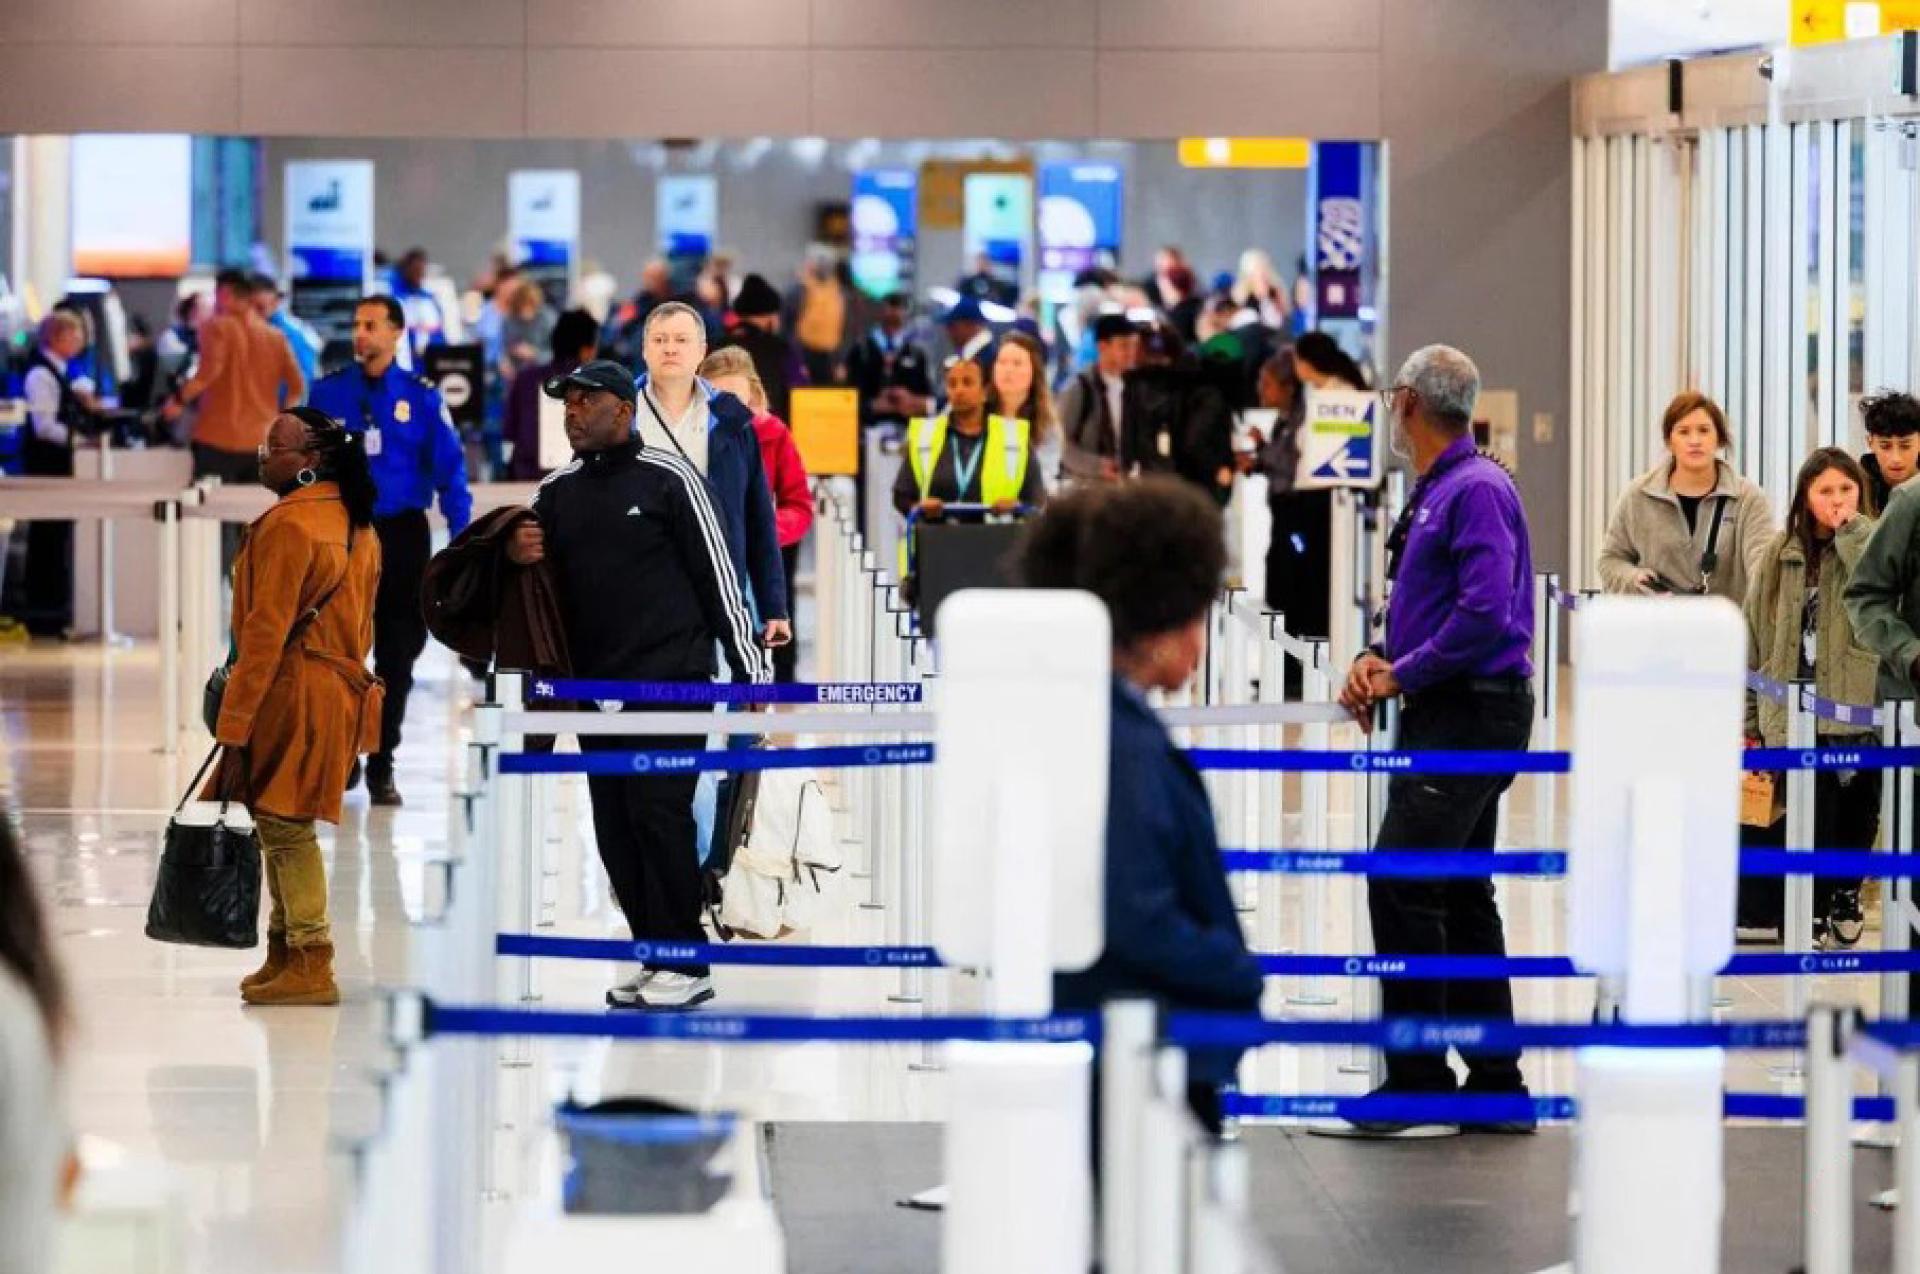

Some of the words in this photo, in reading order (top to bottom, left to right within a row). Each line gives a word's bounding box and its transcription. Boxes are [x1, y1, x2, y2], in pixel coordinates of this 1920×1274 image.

[1318, 405, 1356, 417] DEN
[817, 685, 917, 701] EMERGENCY
[1373, 756, 1412, 768] CLEAR
[1822, 752, 1860, 764] CLEAR
[1366, 959, 1406, 972] CLEAR
[1822, 957, 1860, 969] CLEAR
